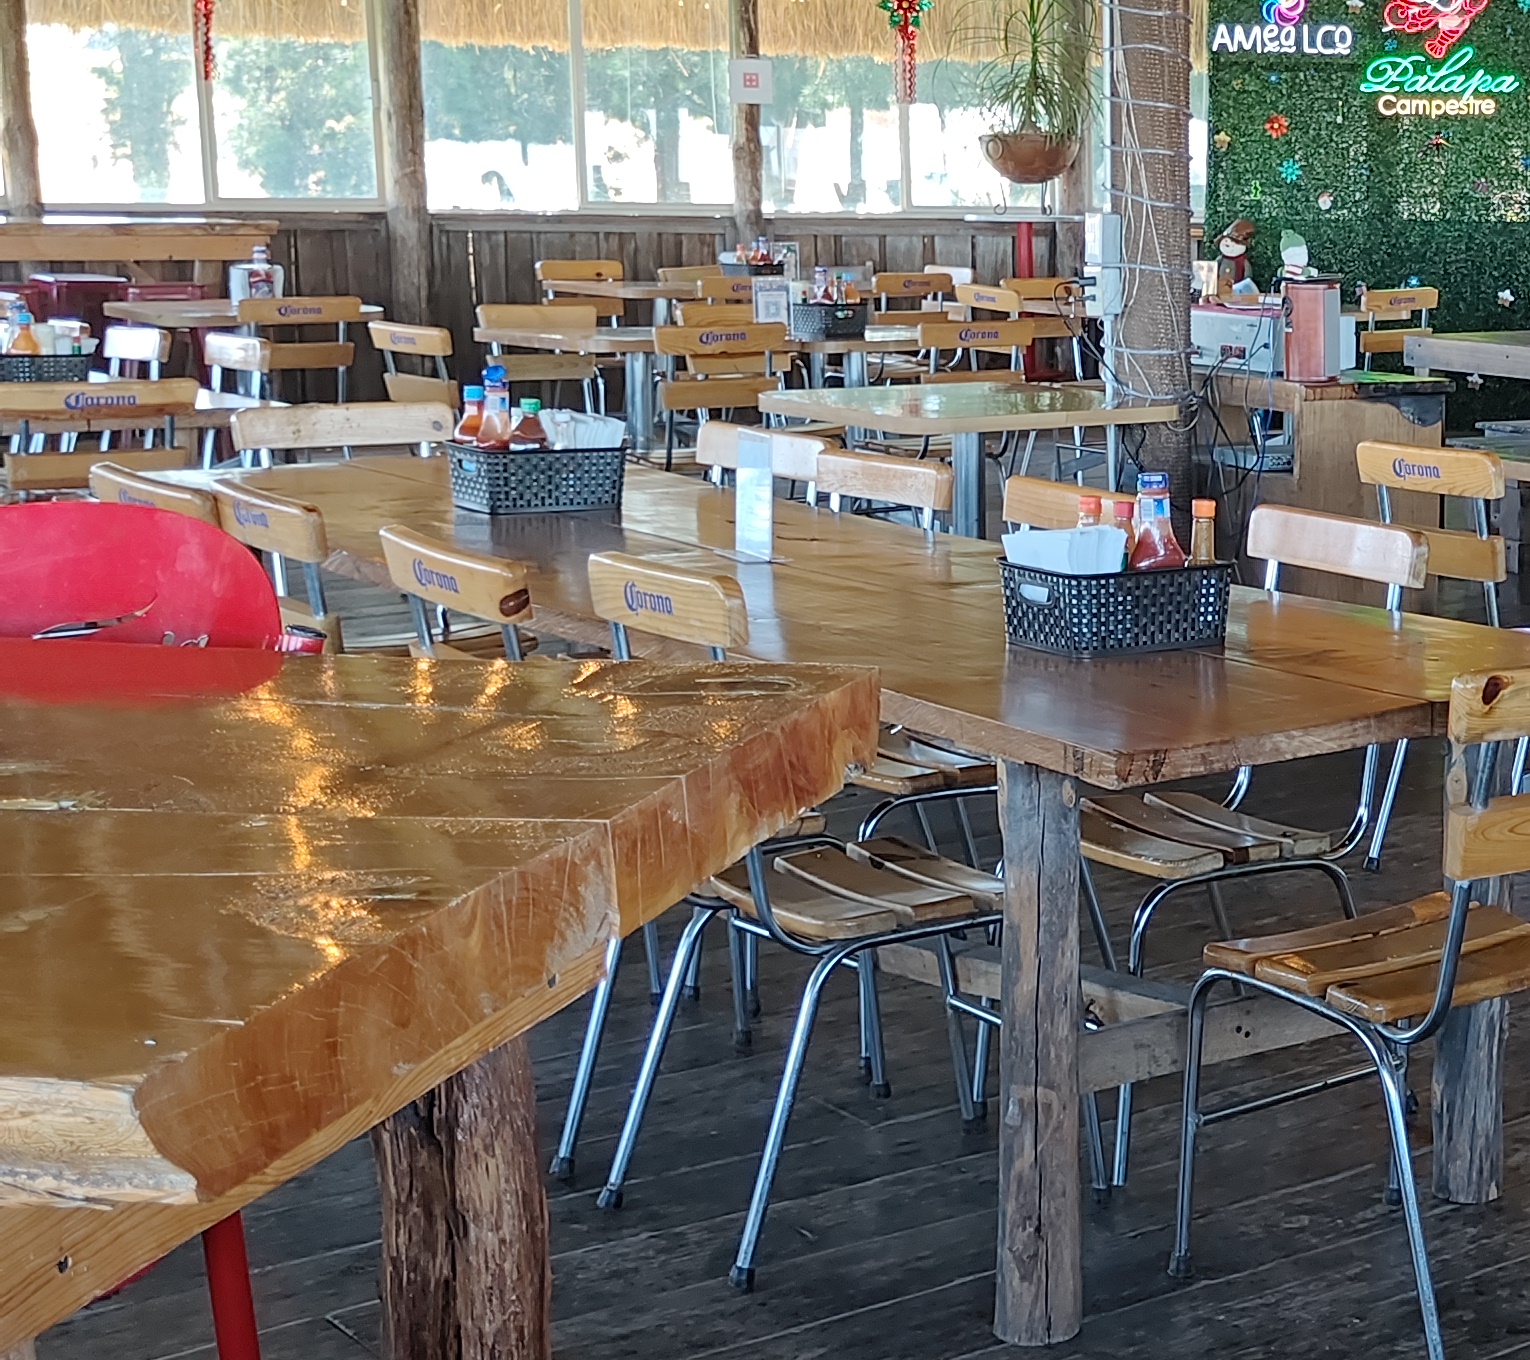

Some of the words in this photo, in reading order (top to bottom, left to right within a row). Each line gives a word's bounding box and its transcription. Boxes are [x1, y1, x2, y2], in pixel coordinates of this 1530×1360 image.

[1360, 46, 1520, 101] Palapa
[1378, 94, 1497, 119] Campestre
[277, 304, 323, 318] Corona
[699, 331, 747, 346] Corona
[959, 328, 1000, 343] Corona
[64, 392, 137, 411] Corona
[1392, 457, 1441, 481] Corona
[412, 557, 461, 594] Corona
[624, 580, 674, 616] Corona
